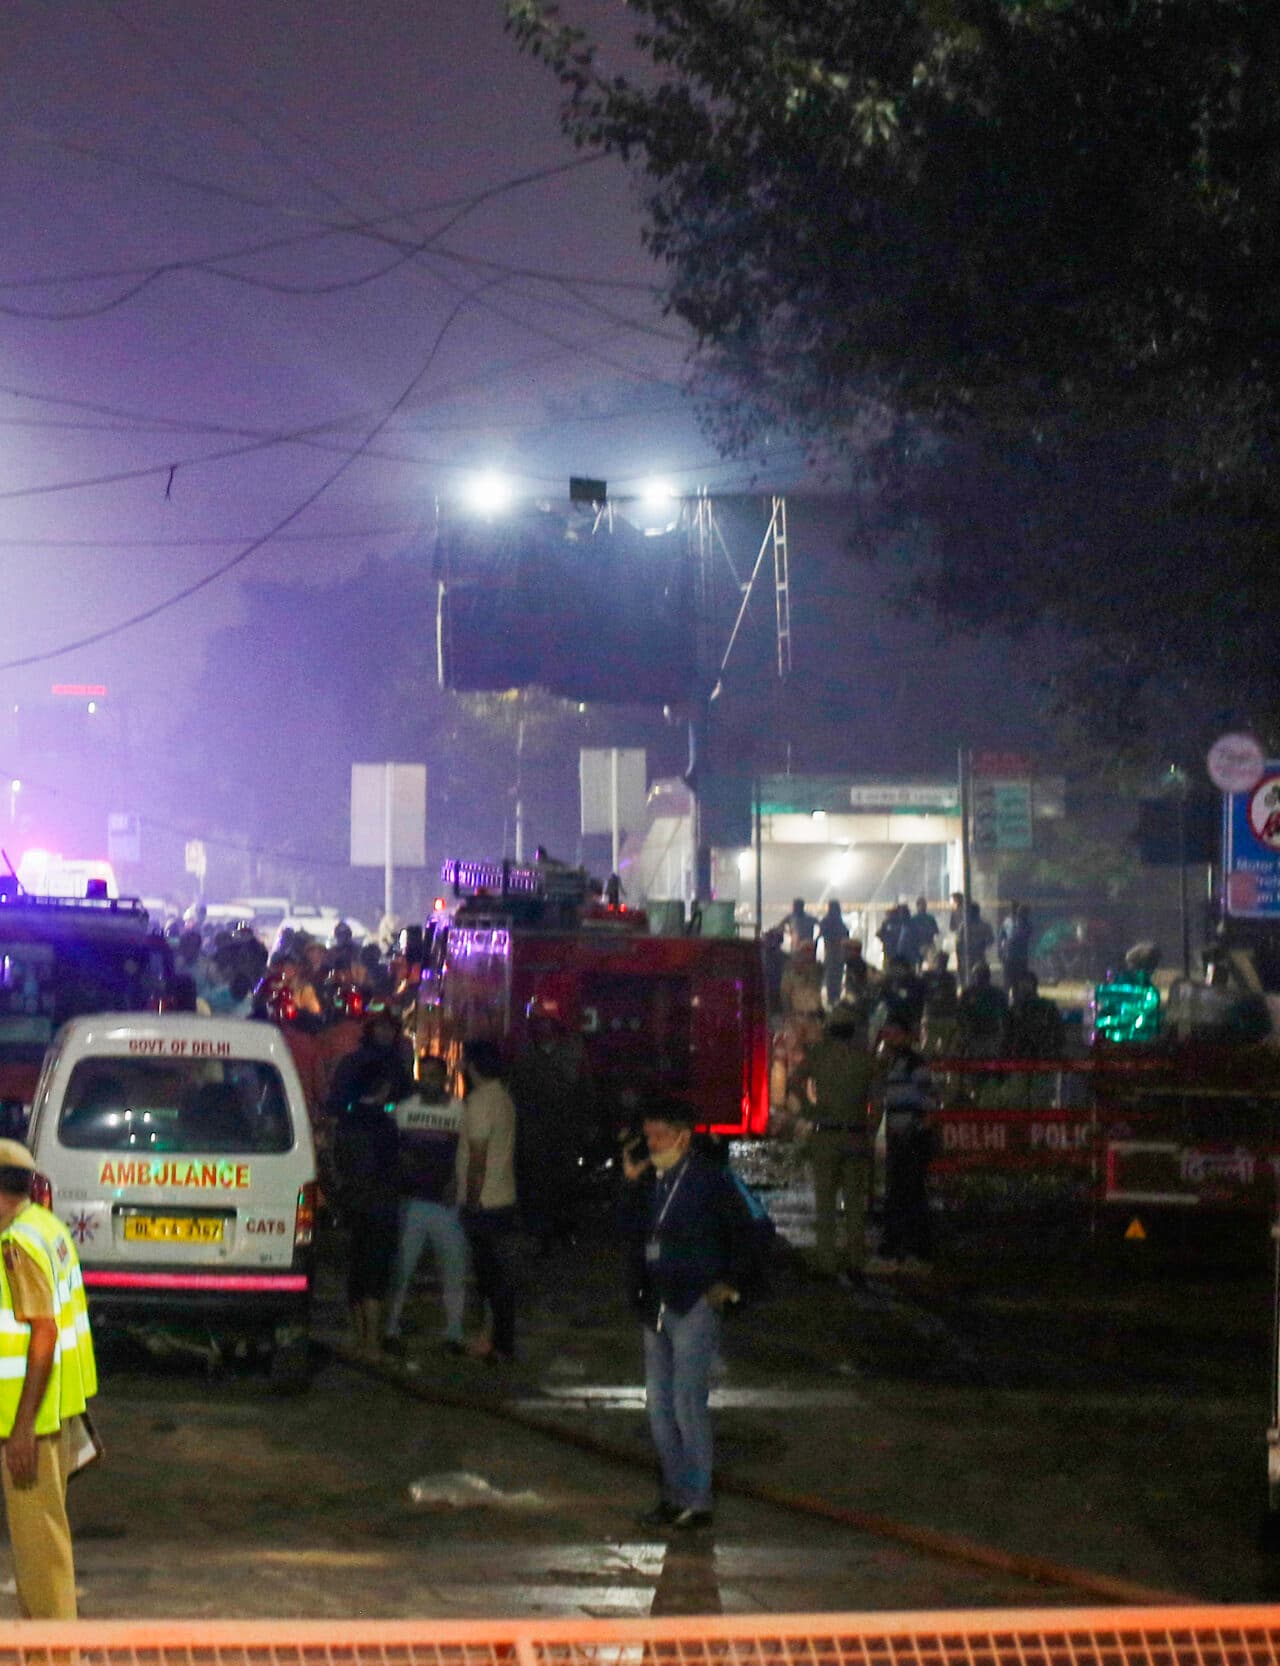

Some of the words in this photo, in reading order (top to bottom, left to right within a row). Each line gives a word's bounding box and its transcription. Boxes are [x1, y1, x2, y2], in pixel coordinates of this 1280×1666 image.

[171, 1040, 187, 1056] OF
[192, 1041, 230, 1056] DELHI
[943, 1122, 1006, 1149] DELHI
[99, 1160, 250, 1189] AMBULANCE
[246, 1219, 286, 1236] CATS
